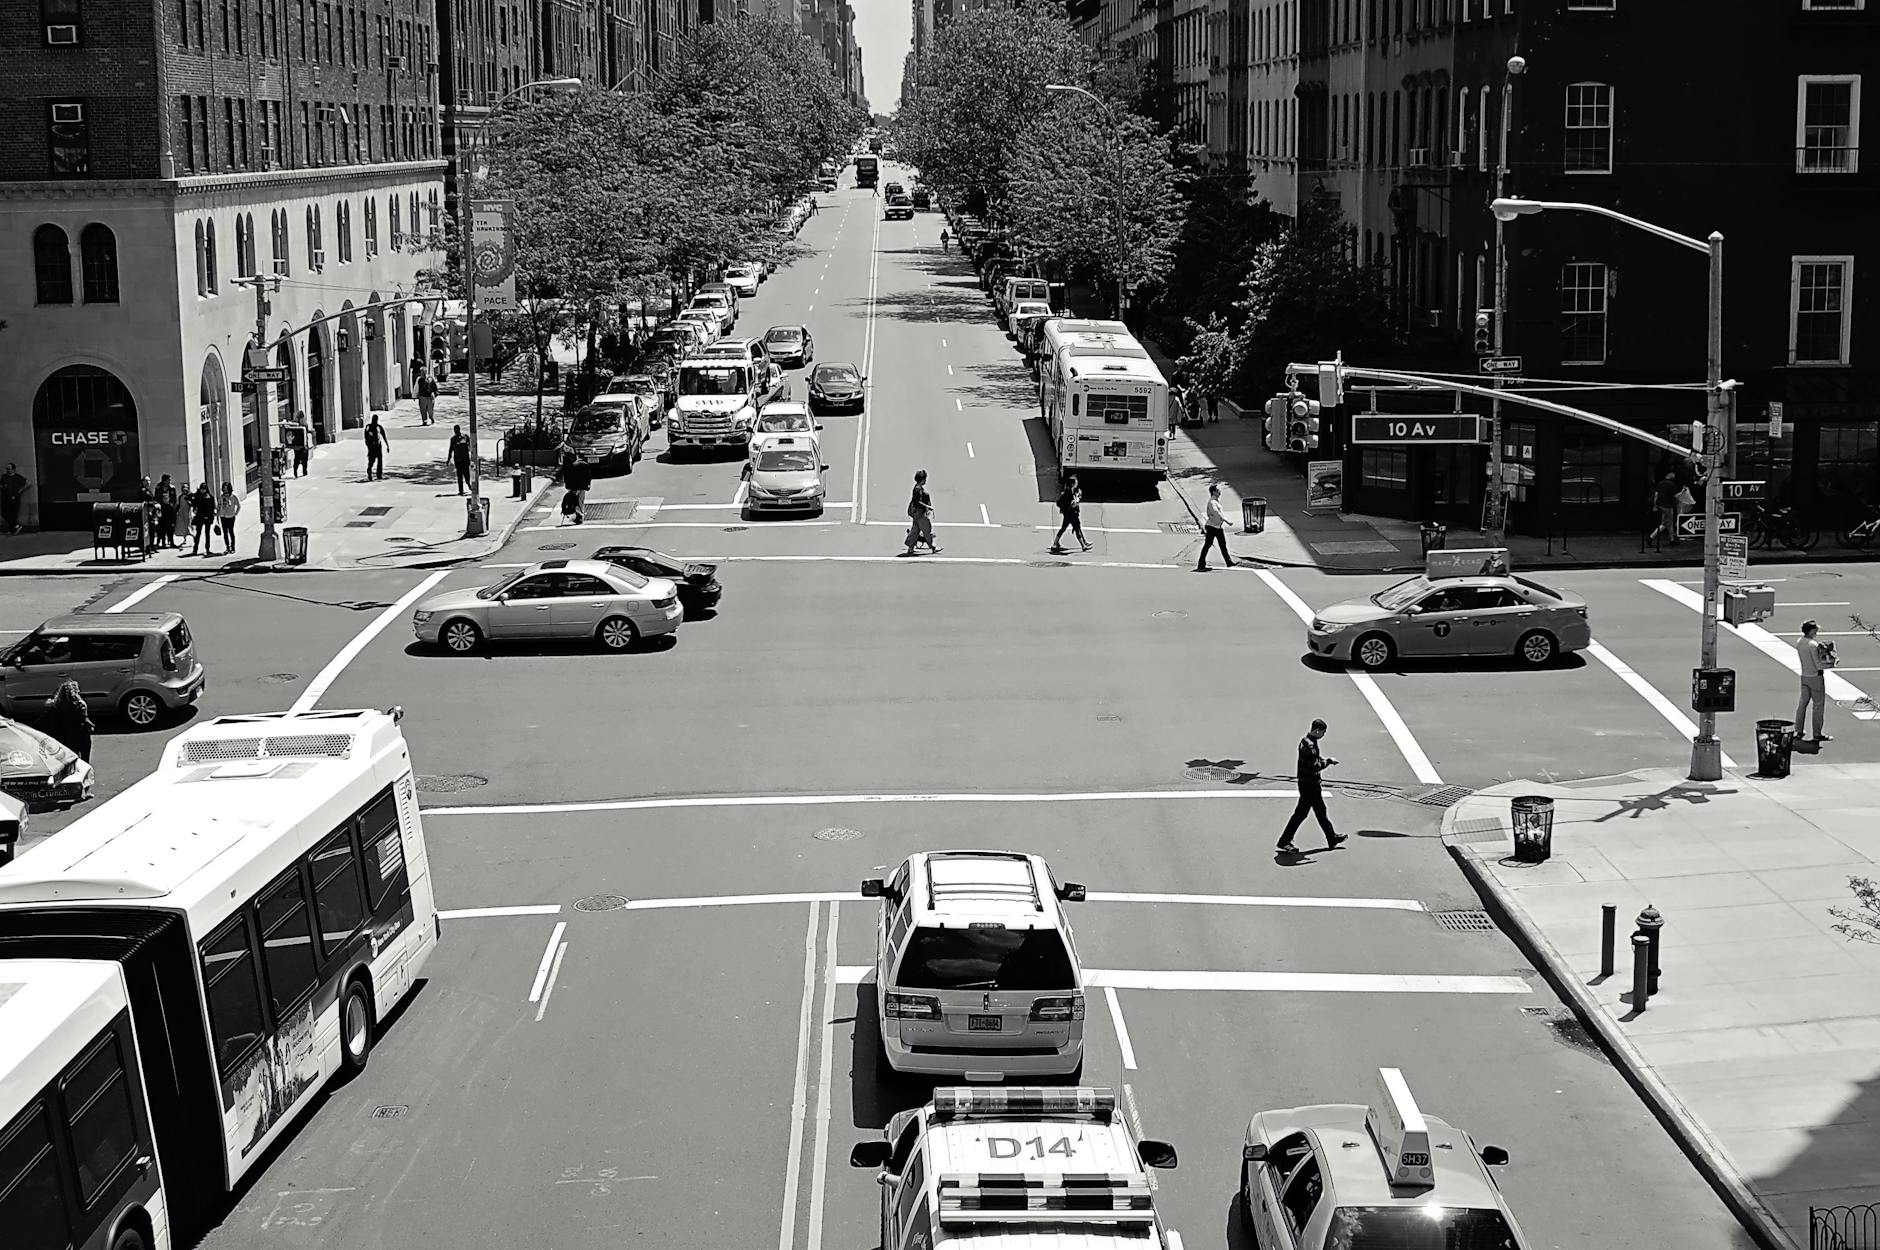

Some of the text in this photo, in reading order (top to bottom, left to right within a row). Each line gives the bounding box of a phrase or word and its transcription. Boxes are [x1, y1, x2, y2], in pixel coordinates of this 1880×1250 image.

[484, 297, 507, 305] PACE
[234, 384, 244, 392] 10
[1388, 422, 1436, 437] 10 Av
[51, 432, 110, 445] CHASE
[1524, 447, 1531, 456] A
[1728, 484, 1743, 497] 10
[1687, 521, 1705, 530] ONE
[1437, 624, 1447, 636] T
[1402, 1154, 1428, 1165] 5H37
